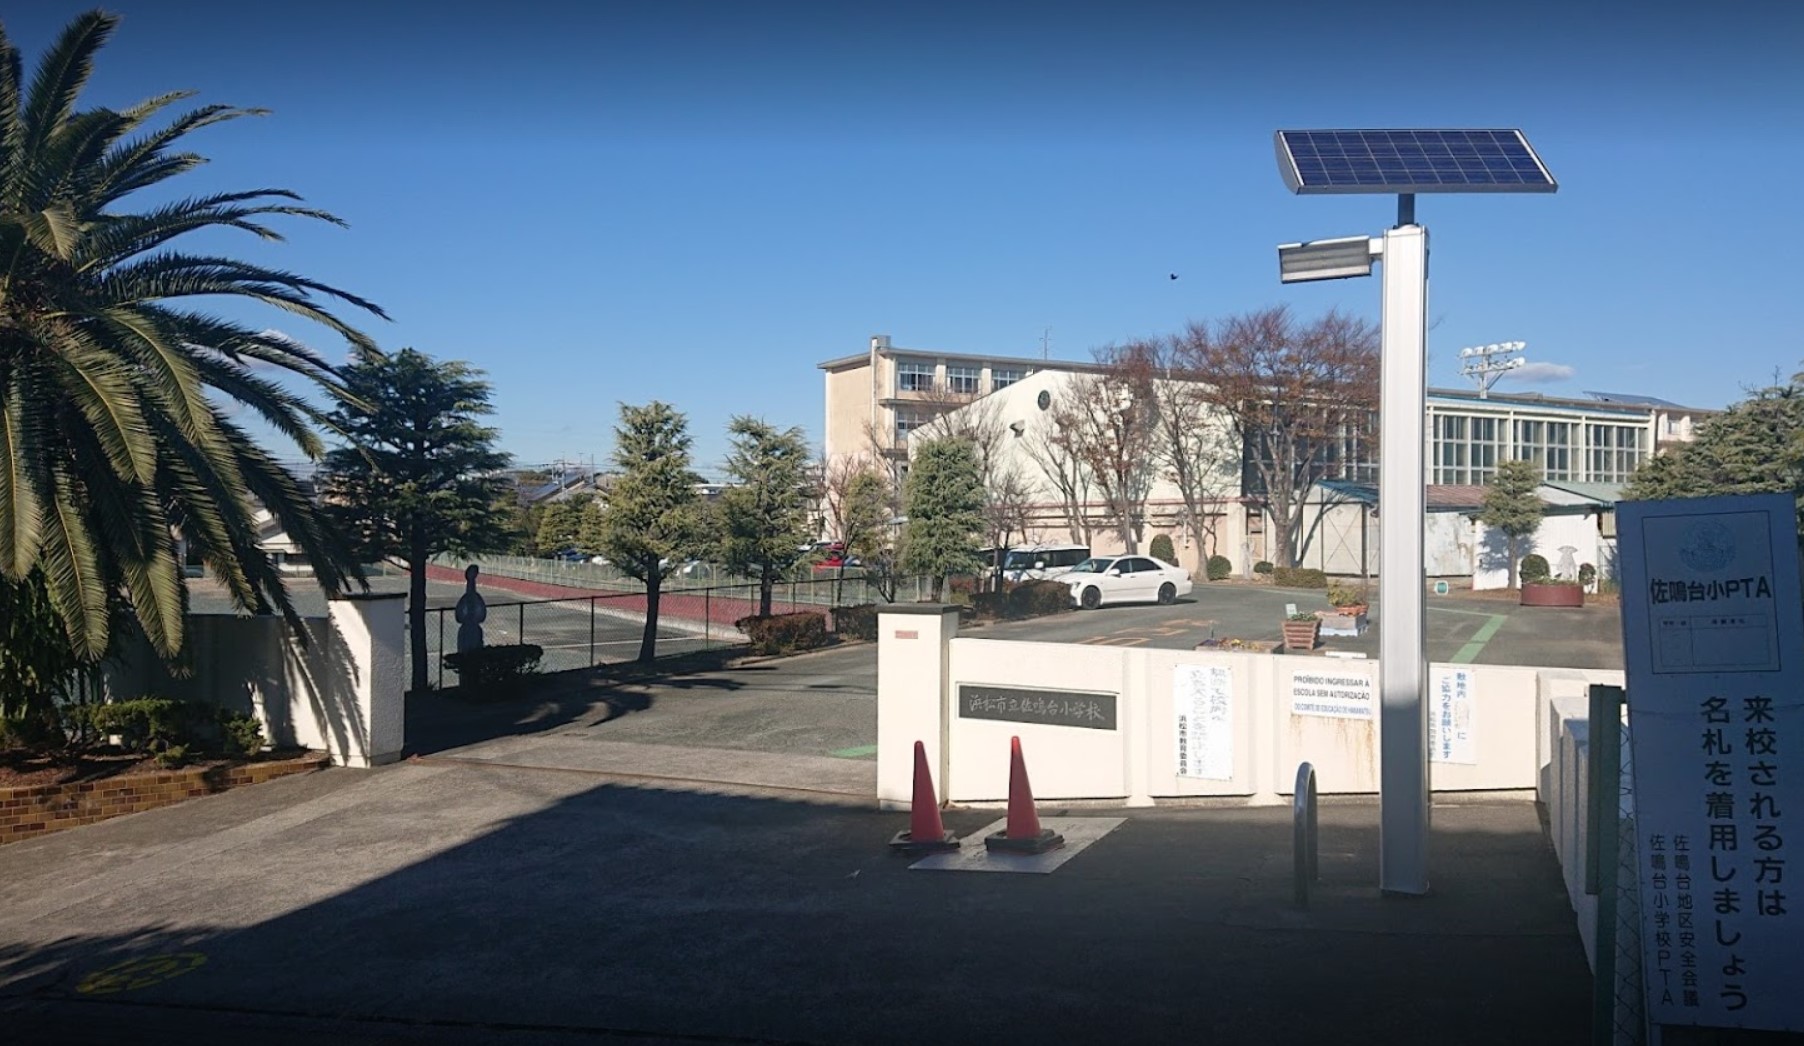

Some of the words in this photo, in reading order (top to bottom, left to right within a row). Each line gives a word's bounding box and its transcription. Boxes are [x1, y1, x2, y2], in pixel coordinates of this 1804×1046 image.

[1651, 575, 1772, 605] 佐鳴台小PTA
[969, 694, 1105, 721] 浜松市立佐鳴台小学校
[1293, 688, 1316, 697] ESCOLA
[1316, 689, 1329, 698] SEM
[1325, 677, 1364, 687] INGRESSAR
[1441, 676, 1452, 759] ご協力をお願いします
[1179, 714, 1188, 775] 浜松市教育委員会
[1743, 695, 1787, 916] 来校される方は
[1701, 696, 1748, 1011] 名札を着用しましょう
[1650, 834, 1674, 1006] 佐鳴台小学校PTA
[1673, 834, 1700, 1007] 佐鳴台地区安全会議
